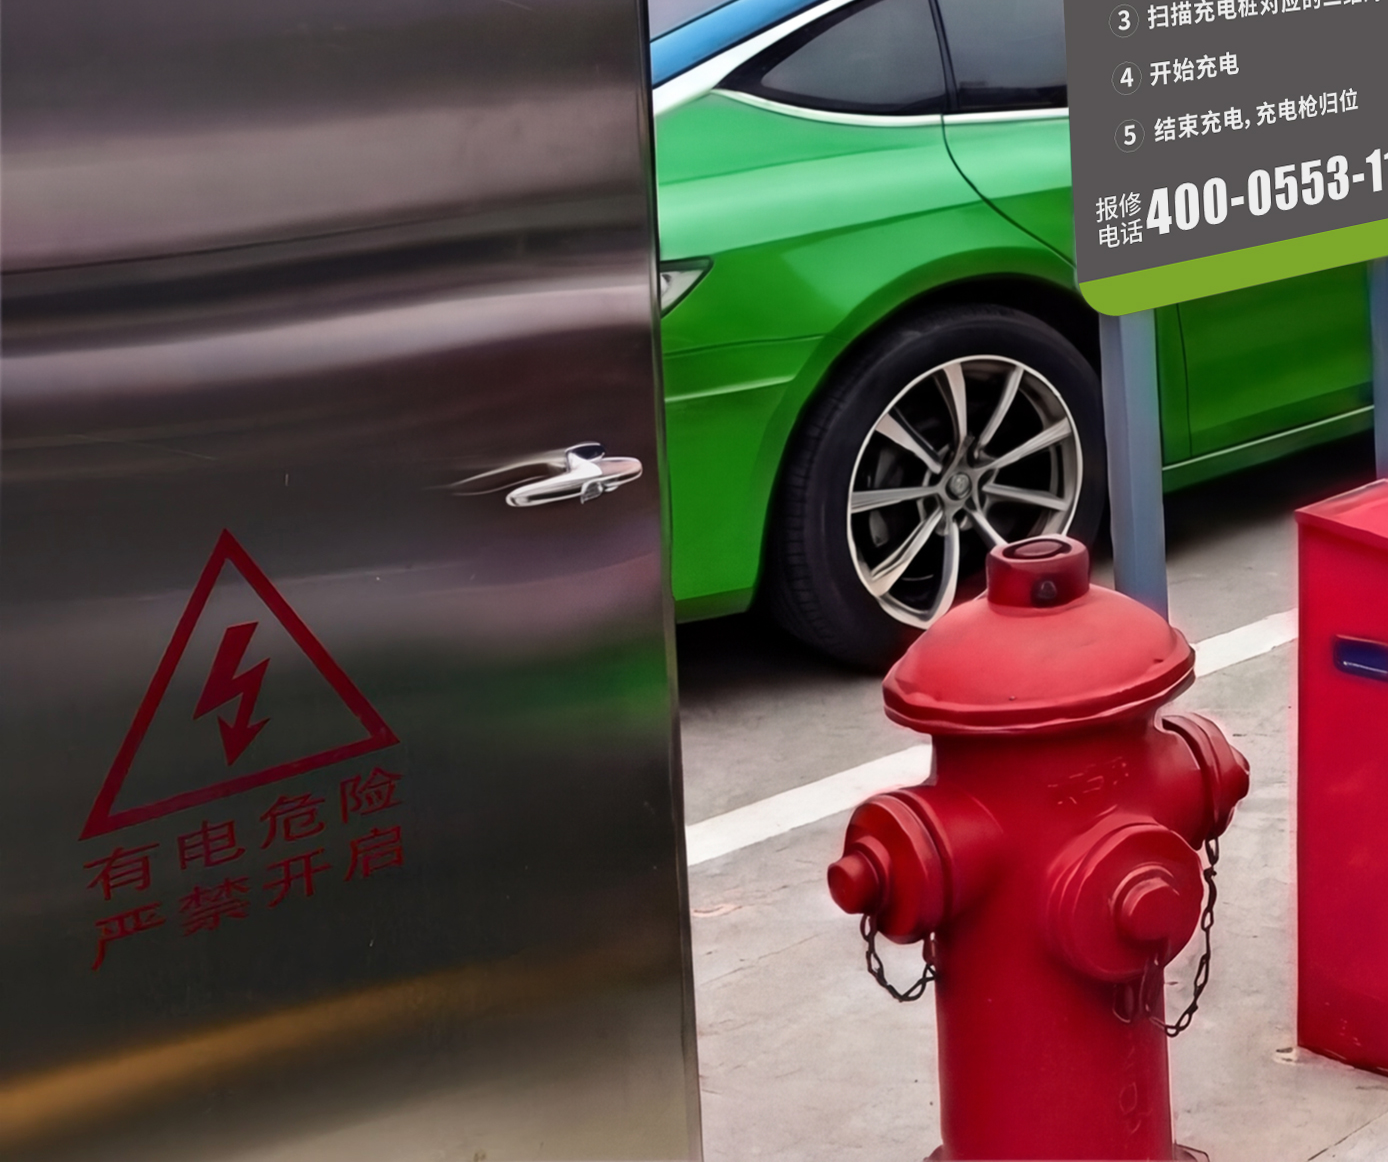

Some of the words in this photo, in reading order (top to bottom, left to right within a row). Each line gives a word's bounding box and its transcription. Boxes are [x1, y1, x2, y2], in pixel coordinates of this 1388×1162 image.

[1117, 9, 1131, 31] 3
[1119, 67, 1134, 88] 4
[1149, 51, 1240, 87] 开始充电
[1123, 124, 1137, 146] 5
[1095, 191, 1142, 222] 报修
[1098, 219, 1143, 249] 电话
[83, 764, 404, 900] 有电危险
[92, 826, 404, 970] 严禁开启
